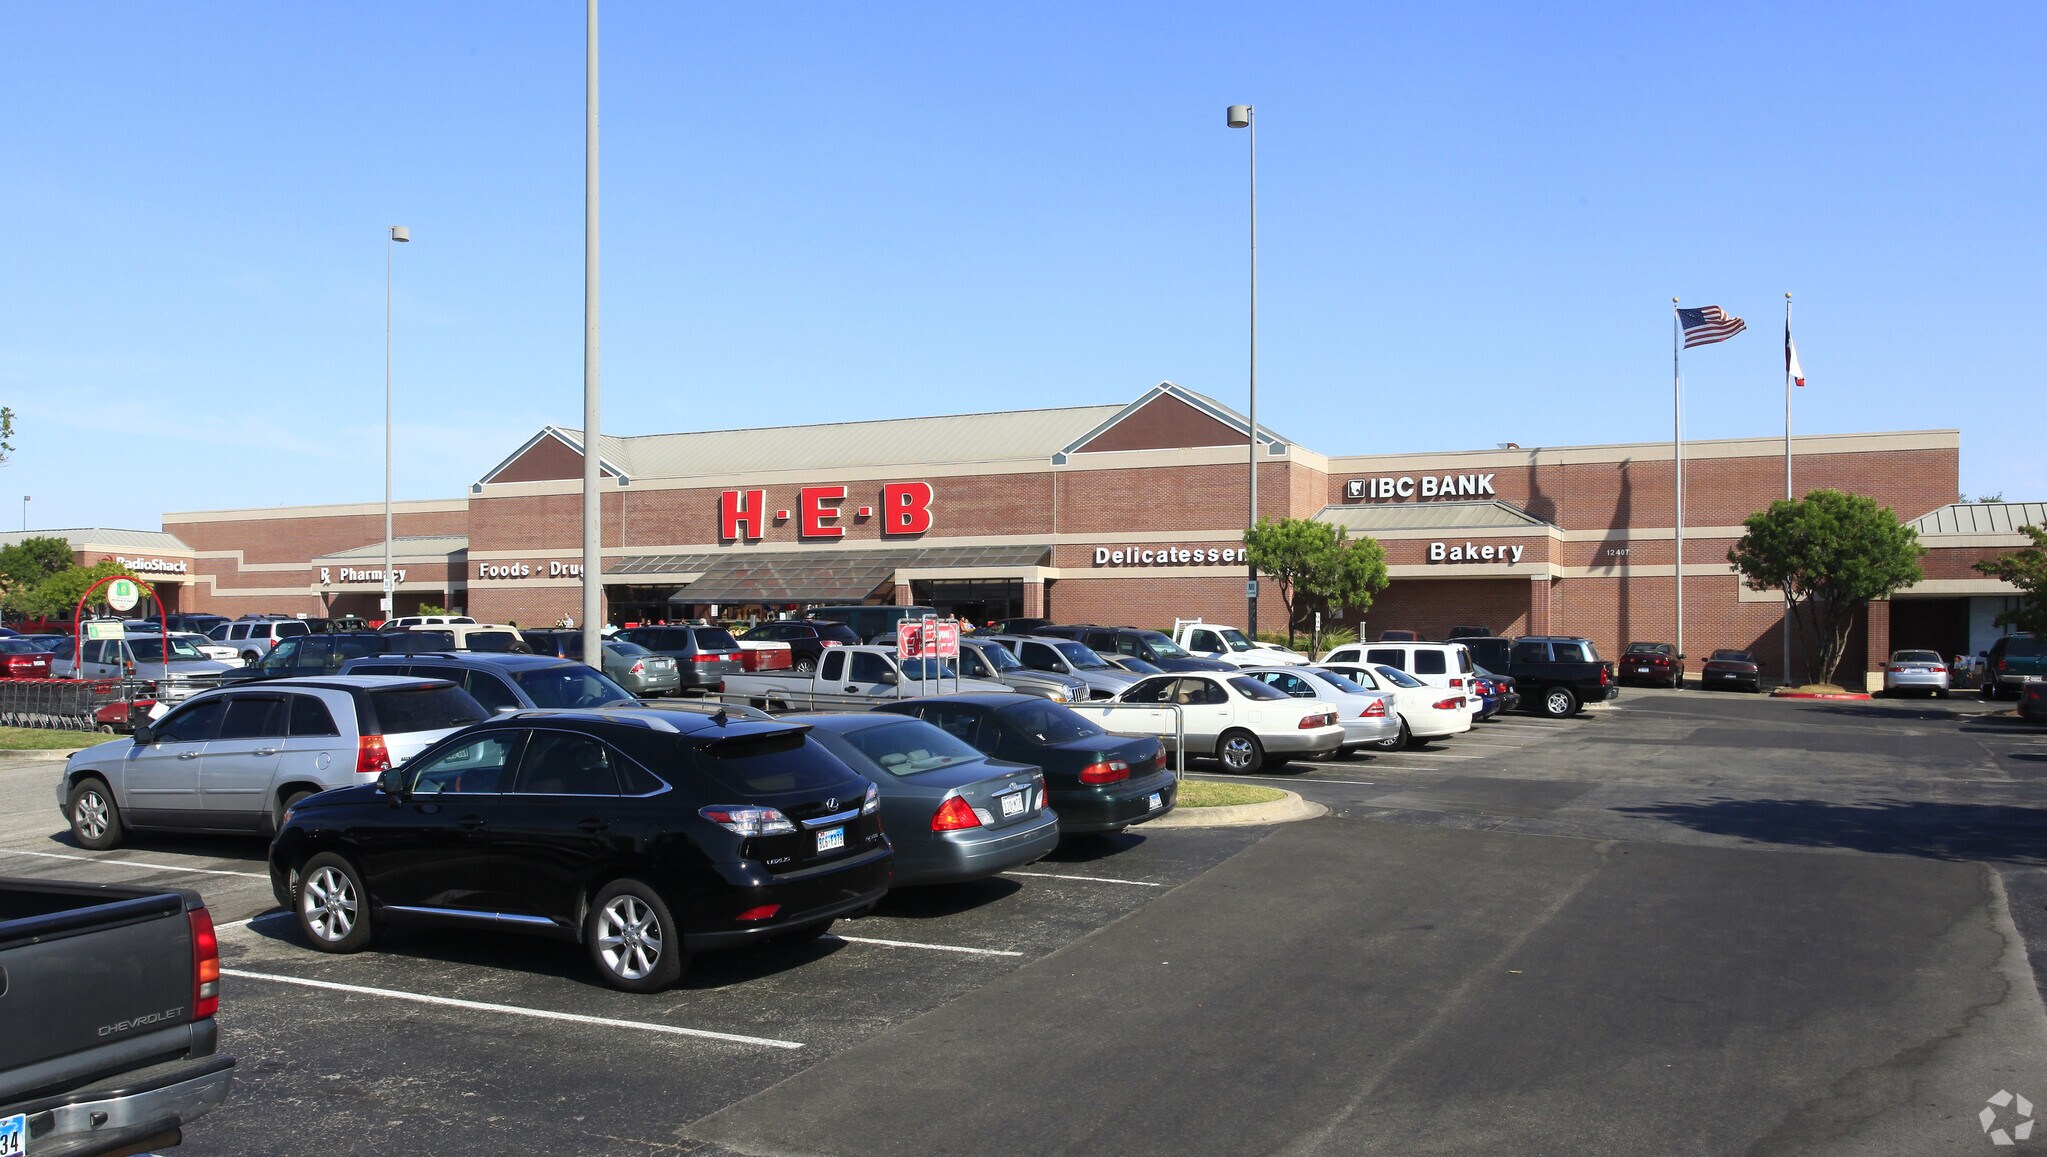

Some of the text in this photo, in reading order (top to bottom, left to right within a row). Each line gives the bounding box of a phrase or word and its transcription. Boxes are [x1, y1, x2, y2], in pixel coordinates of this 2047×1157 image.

[1370, 473, 1496, 499] IBC BANK
[1430, 542, 1524, 562] Bakery
[479, 562, 530, 577] Foods
[98, 1006, 185, 1036] CHEVROLET
